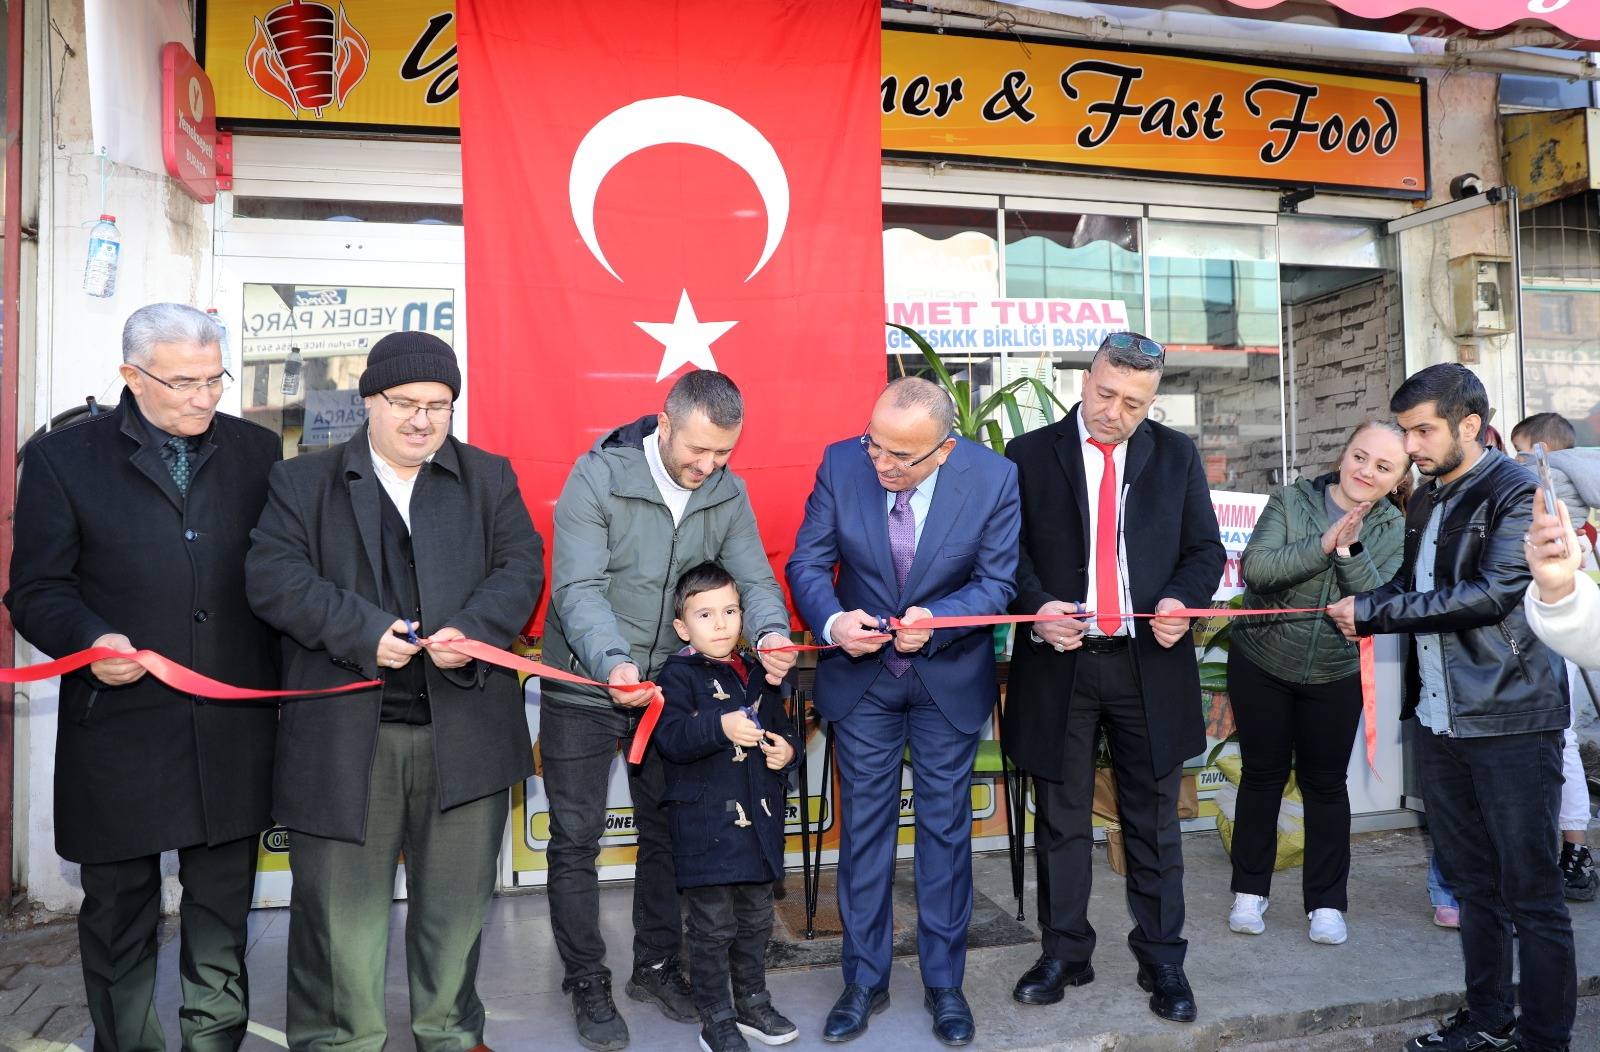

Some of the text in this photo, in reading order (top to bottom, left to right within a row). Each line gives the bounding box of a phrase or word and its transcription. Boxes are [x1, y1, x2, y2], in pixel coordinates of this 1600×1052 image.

[400, 11, 459, 105] Y
[982, 70, 1036, 122] &
[1060, 59, 1224, 149] Fast
[1244, 78, 1399, 164] Food
[178, 108, 213, 160] Yemeksepeti
[186, 149, 207, 177] BURADA
[885, 301, 1124, 326] MET TURAL
[886, 329, 912, 348] GE
[984, 324, 1047, 348] BİRLİĞİ
[1052, 326, 1128, 351] BAŞKA
[1200, 772, 1231, 785] TAVU
[606, 814, 637, 829] ÖNE
